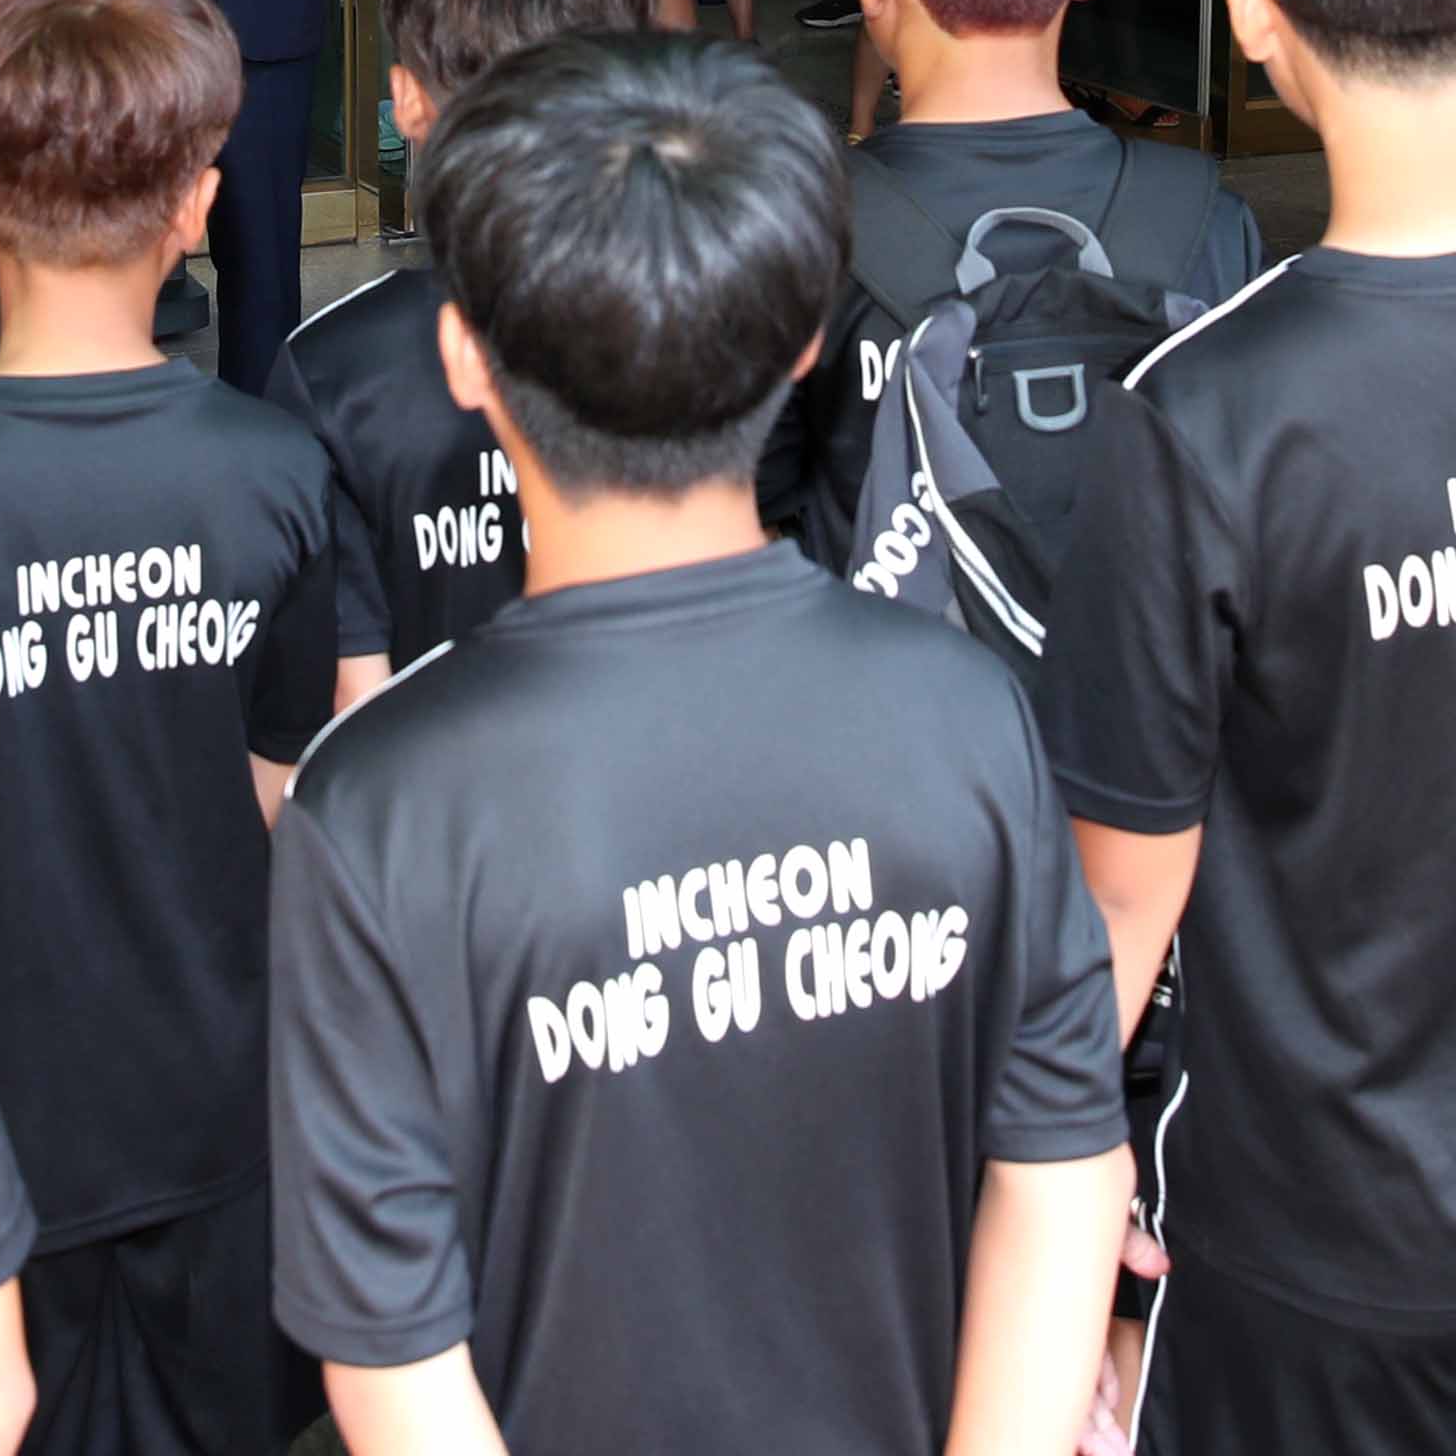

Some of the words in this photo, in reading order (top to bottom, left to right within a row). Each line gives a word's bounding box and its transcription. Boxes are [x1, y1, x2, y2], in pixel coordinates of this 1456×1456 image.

[413, 502, 503, 571] DONG
[16, 544, 202, 616] INCHEON
[66, 610, 119, 683] GU
[136, 599, 261, 672] CHEONG
[623, 837, 874, 960] INCHEON
[527, 962, 671, 1083] DONG
[692, 937, 762, 1042] GU
[785, 905, 969, 1021] CHEONG
